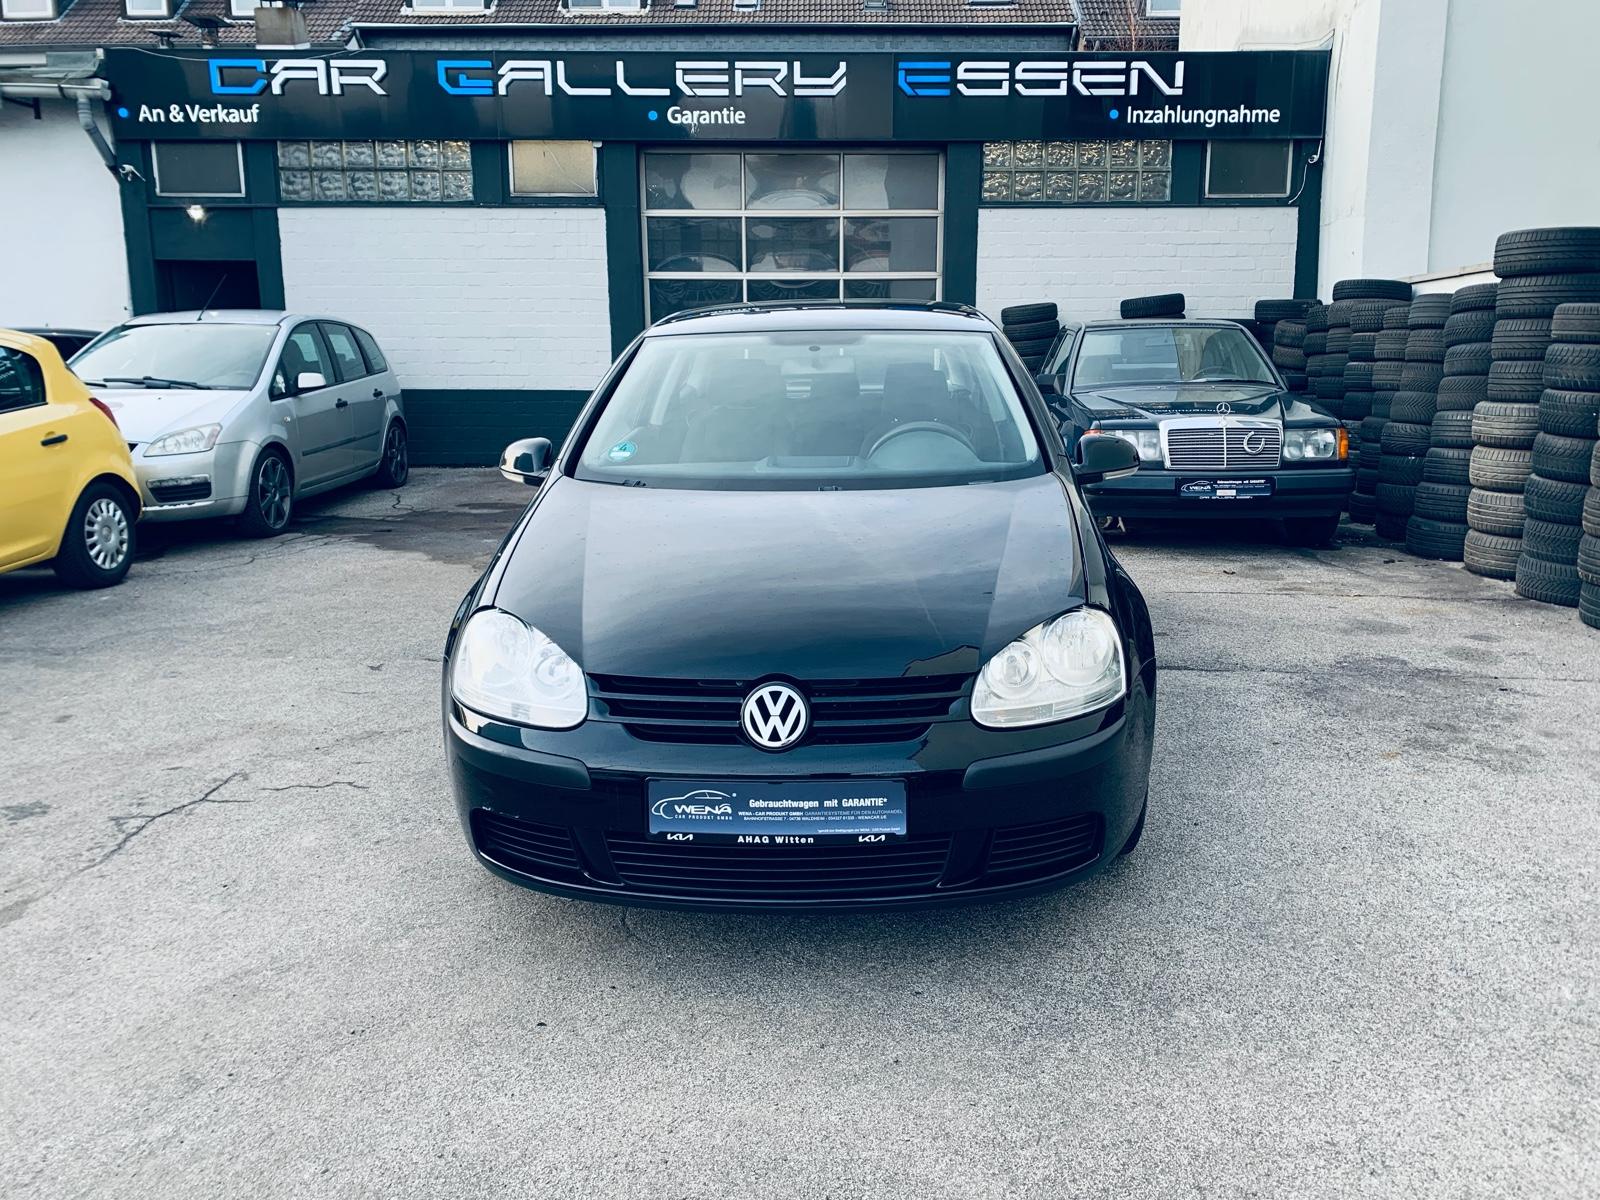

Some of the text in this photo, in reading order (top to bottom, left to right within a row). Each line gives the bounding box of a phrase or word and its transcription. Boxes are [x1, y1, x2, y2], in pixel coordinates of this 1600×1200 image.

[208, 59, 1185, 97] CAR GALLERY ESSEN
[138, 103, 260, 123] An & Verkauf
[666, 106, 747, 125] Garantie
[1127, 104, 1281, 128] Inzahlungnahme
[743, 685, 807, 748] VW
[749, 799, 819, 810] Gebrauchtwagen
[823, 799, 839, 808] mit
[737, 835, 814, 844] AHAG Witten
